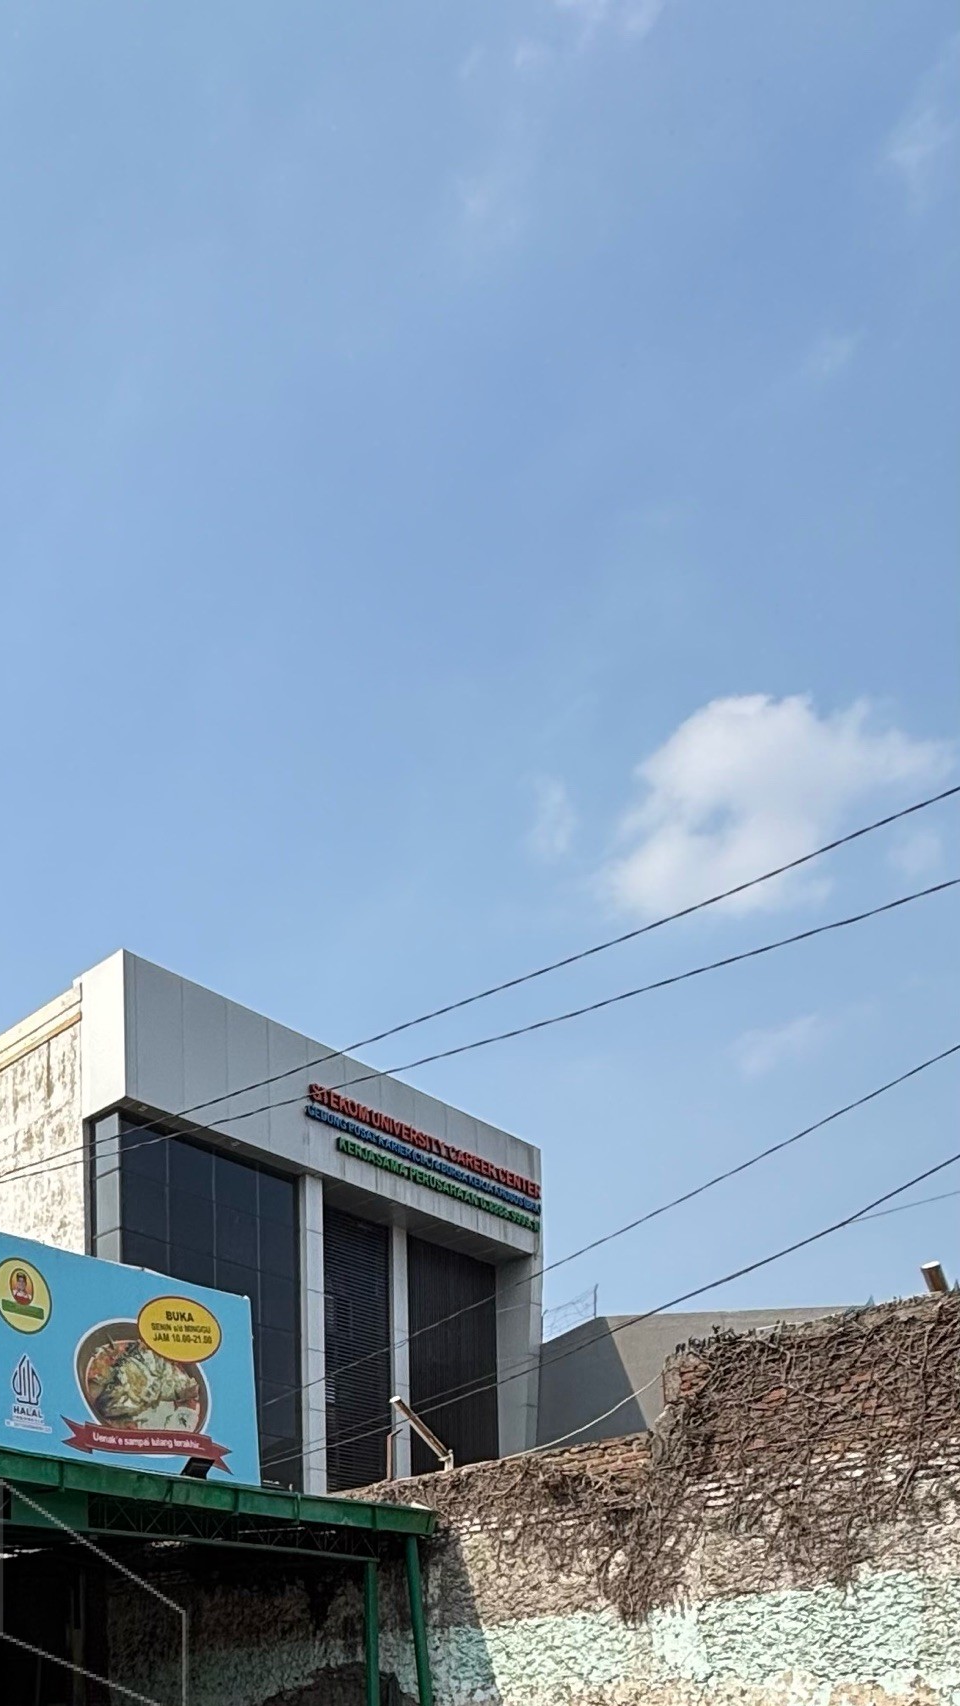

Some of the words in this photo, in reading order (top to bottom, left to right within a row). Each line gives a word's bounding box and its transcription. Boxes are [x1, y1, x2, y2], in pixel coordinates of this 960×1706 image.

[309, 1083, 371, 1122] STEKOM
[371, 1109, 449, 1160] UNIVERSITY
[449, 1144, 499, 1180] CAREER
[499, 1167, 541, 1200] CENTER
[165, 1311, 195, 1322] BUKA
[185, 1325, 211, 1334] MINGGU
[153, 1332, 170, 1342] JAM
[14, 1405, 43, 1419] HALAL
[125, 1437, 150, 1448] sampai
